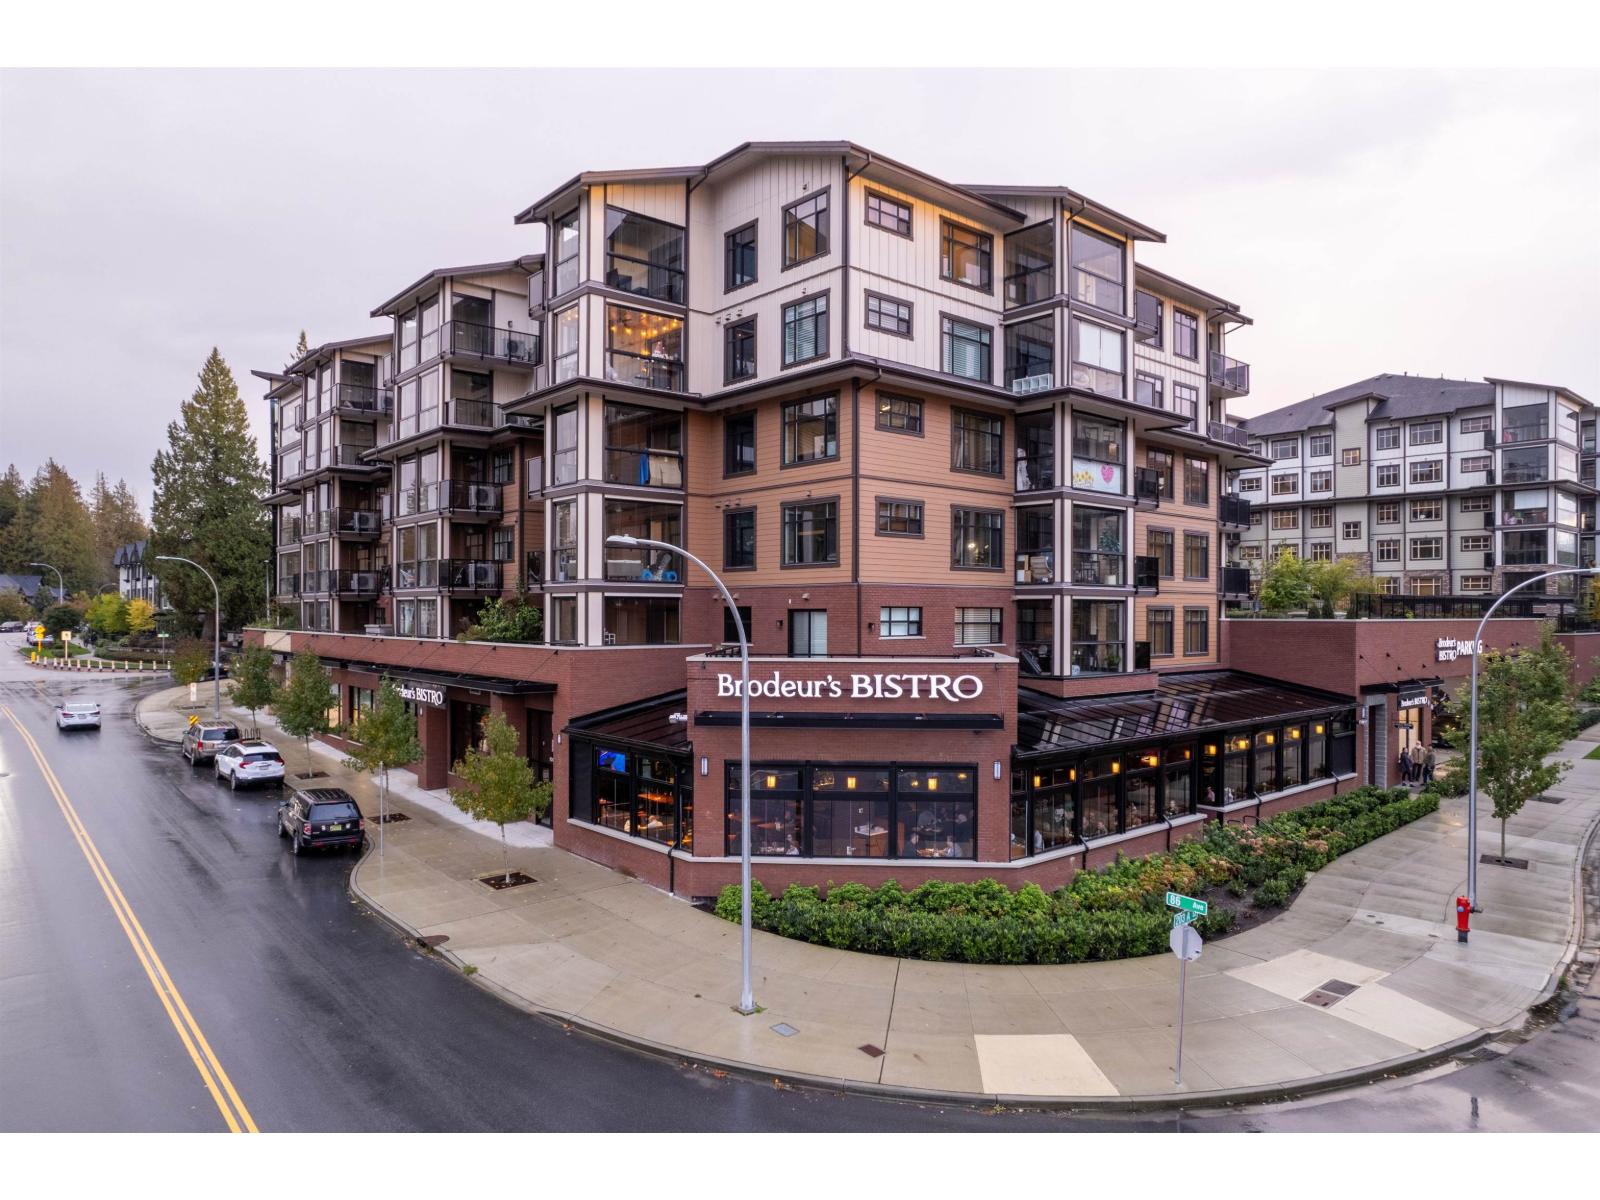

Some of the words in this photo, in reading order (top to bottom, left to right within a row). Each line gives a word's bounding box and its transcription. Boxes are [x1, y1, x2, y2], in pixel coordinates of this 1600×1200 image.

[717, 671, 842, 698] Brodeur's
[850, 674, 983, 702] BISTRO
[416, 687, 443, 706] BISTRO
[1170, 894, 1181, 906] 86
[1192, 901, 1204, 911] Ave
